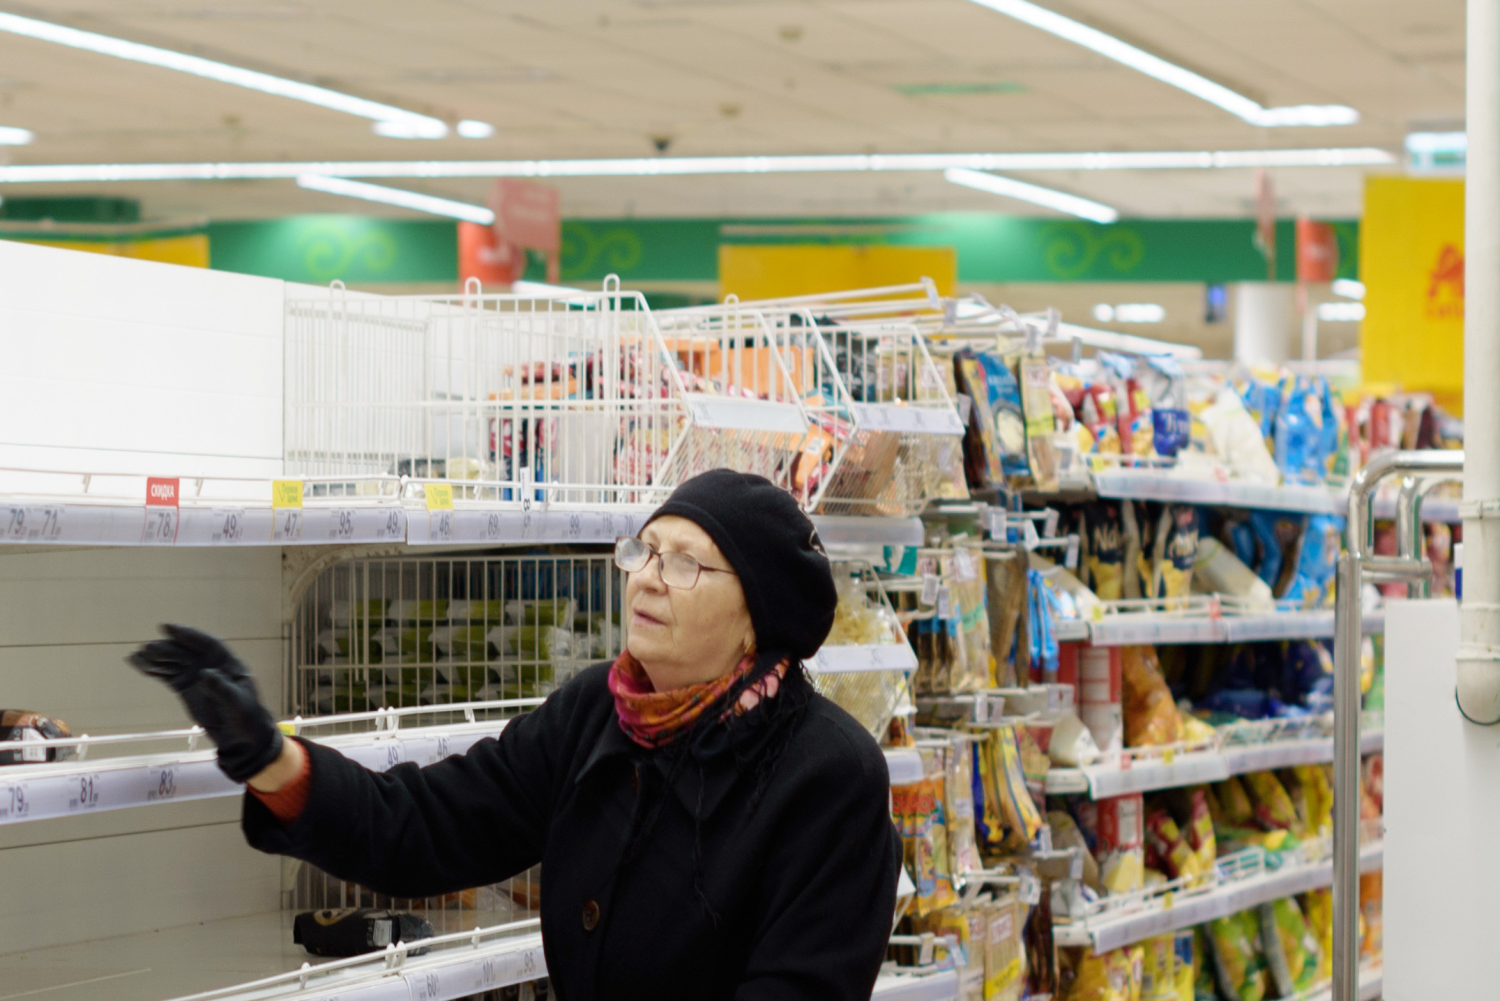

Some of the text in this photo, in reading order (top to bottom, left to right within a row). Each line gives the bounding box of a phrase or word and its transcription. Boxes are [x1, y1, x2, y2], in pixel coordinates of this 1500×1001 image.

[151, 484, 175, 501] СКИДКА
[8, 508, 25, 535] 79
[42, 509, 58, 536] 71
[157, 512, 171, 537] 78
[223, 513, 237, 539] 49
[284, 512, 298, 537] 47
[339, 511, 352, 535] 95
[387, 511, 399, 535] 49
[80, 776, 95, 803] 81
[159, 771, 174, 796] 83
[9, 787, 24, 814] 79
[426, 973, 437, 998] 60
